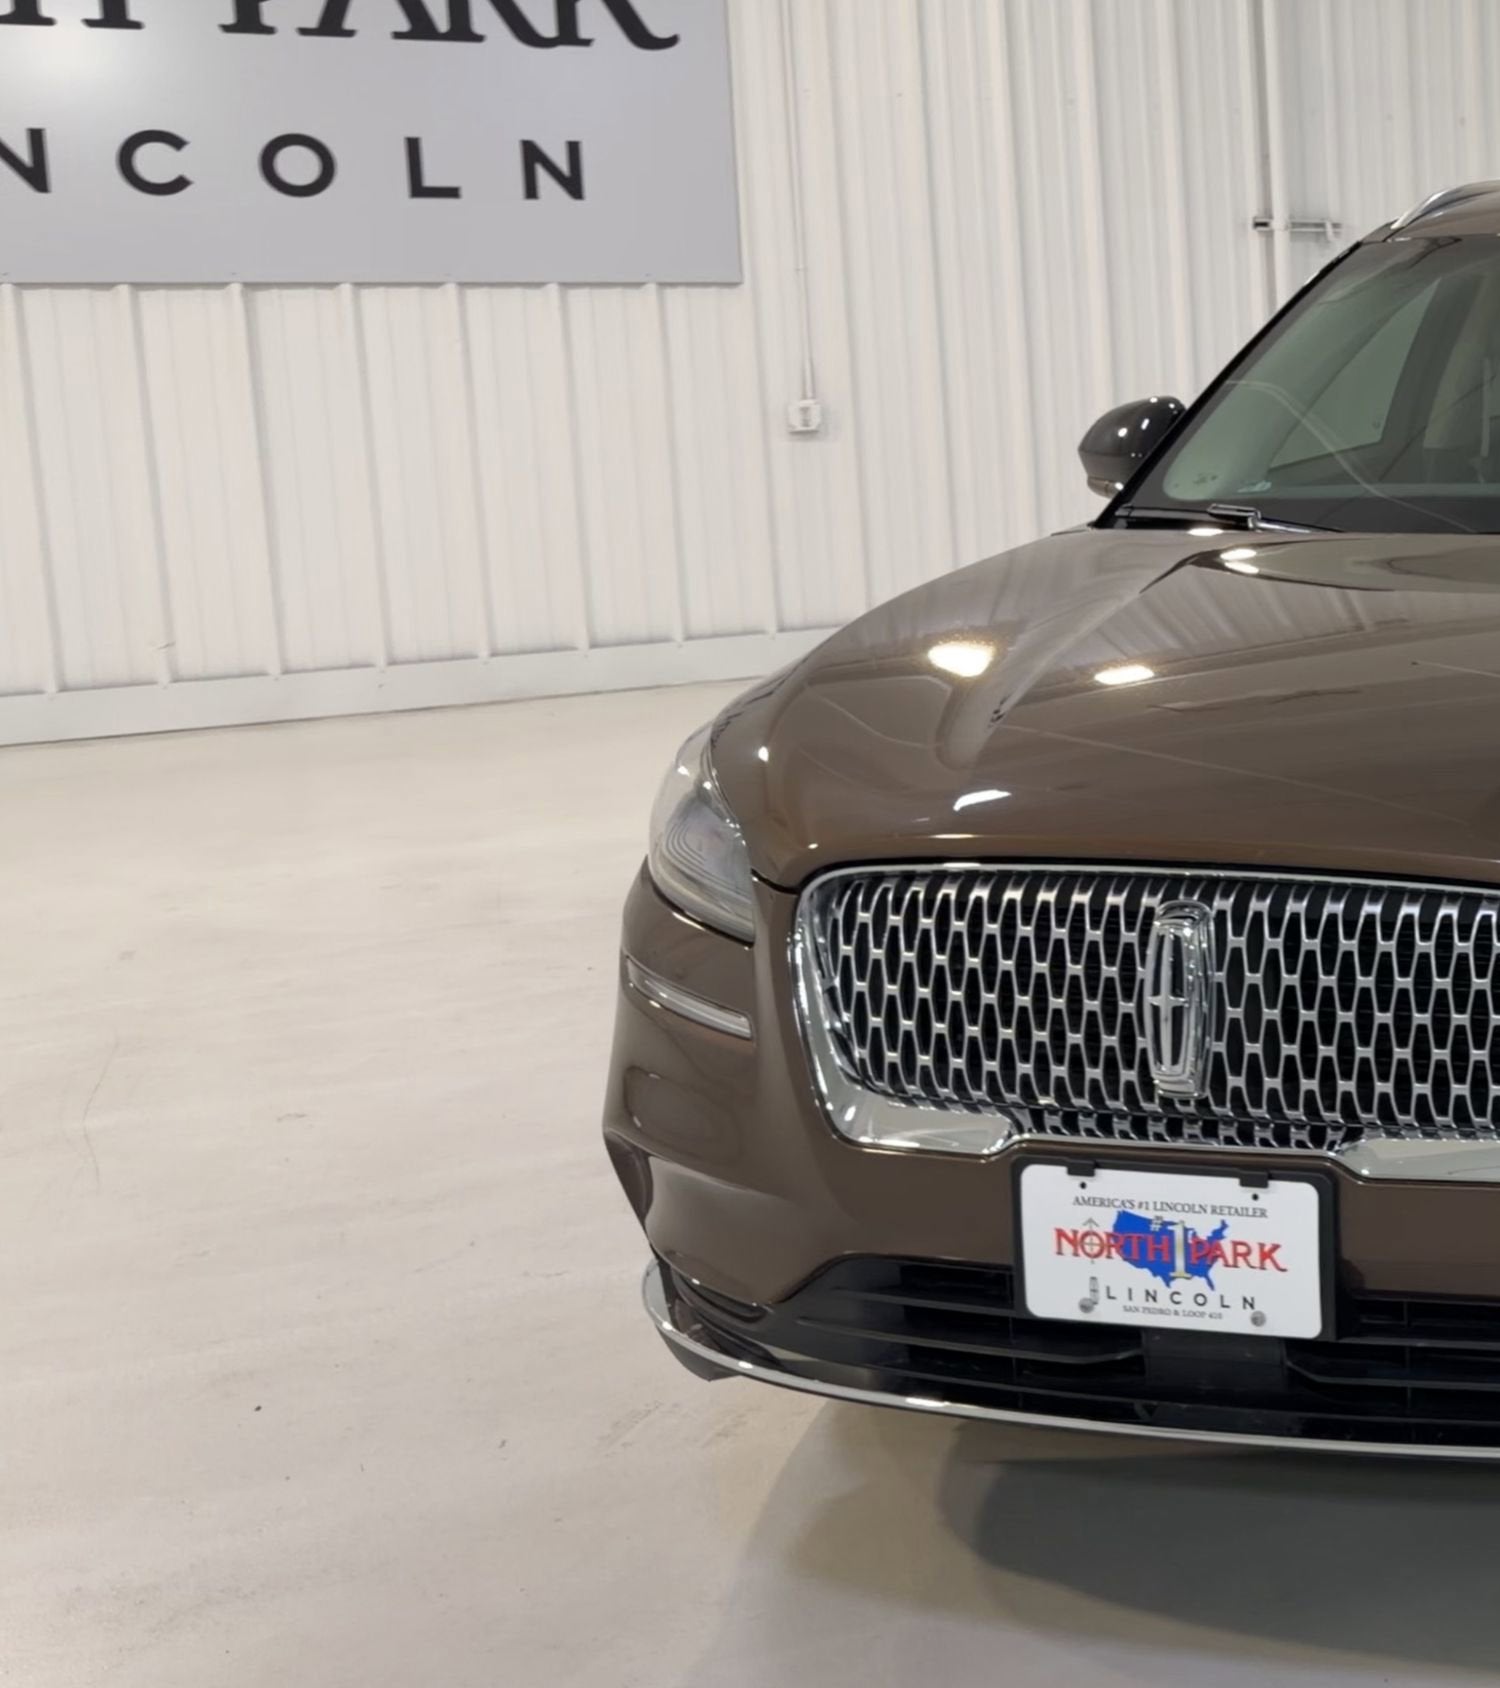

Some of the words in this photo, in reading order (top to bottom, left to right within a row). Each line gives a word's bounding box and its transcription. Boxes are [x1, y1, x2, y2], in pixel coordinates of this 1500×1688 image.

[1072, 1196, 1136, 1210] AMERICA'S
[1137, 1200, 1150, 1211] #1
[1153, 1201, 1209, 1215] LINCOLN
[1210, 1205, 1269, 1219] RETAILER
[1054, 1227, 1171, 1264] NORTH
[1188, 1234, 1288, 1273] PARK
[1106, 1285, 1255, 1311] LINCOLN
